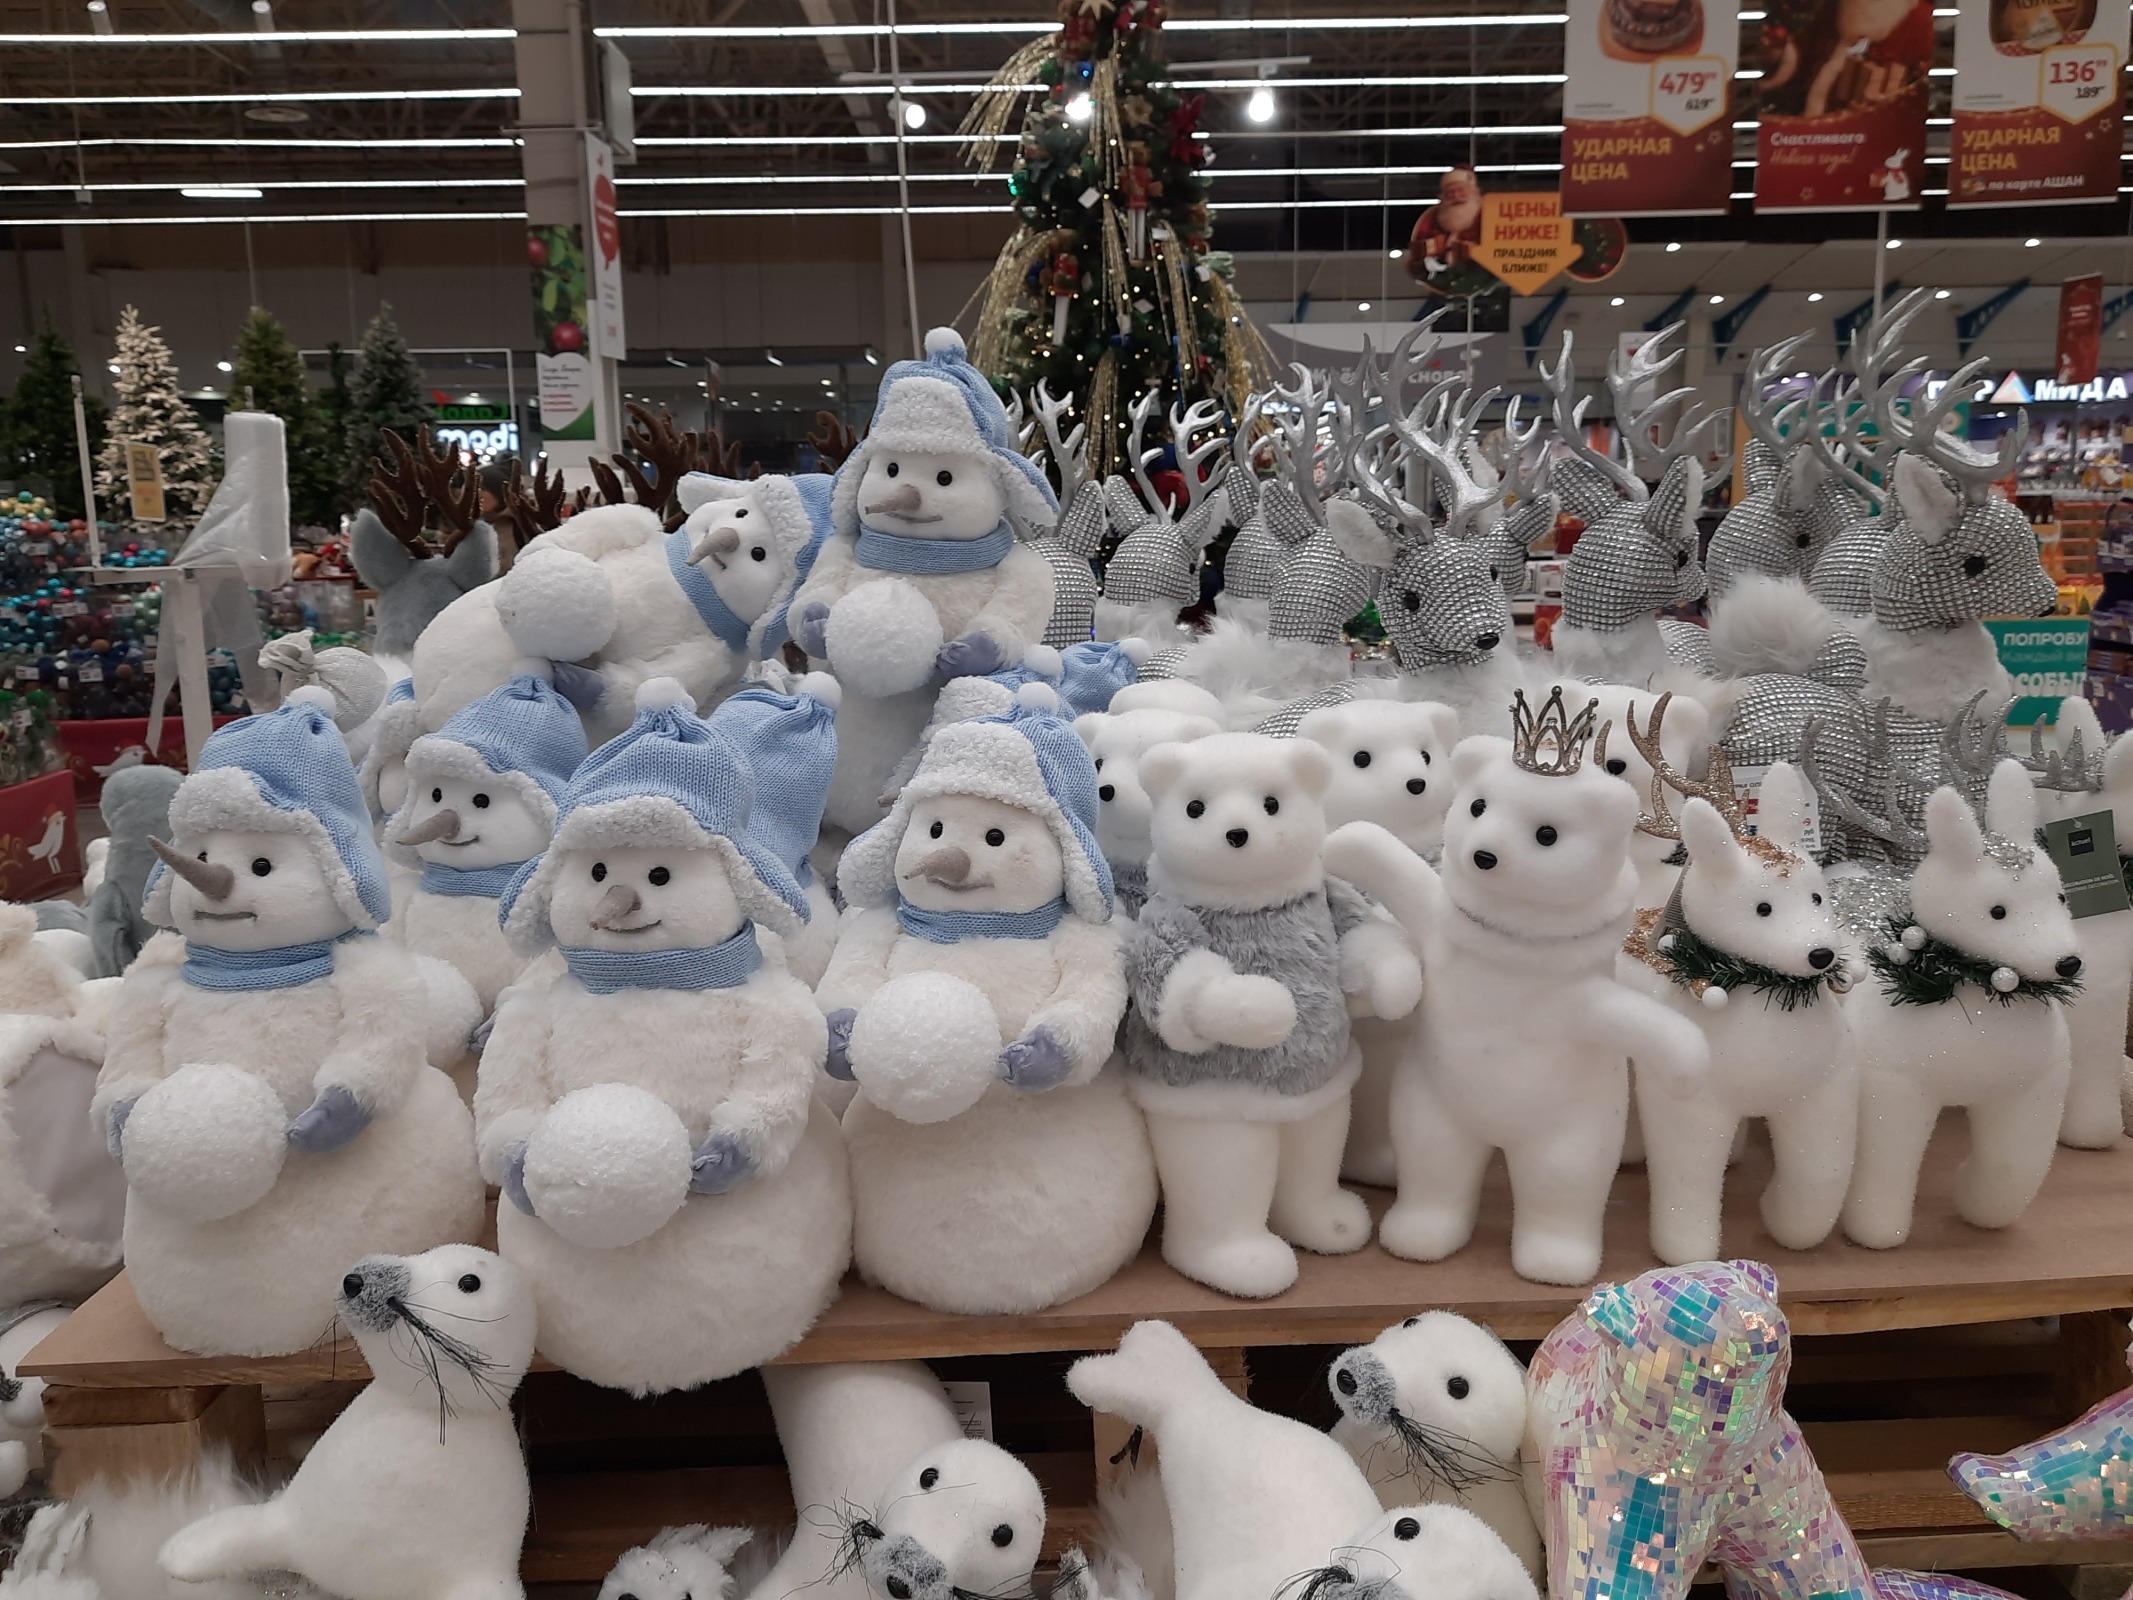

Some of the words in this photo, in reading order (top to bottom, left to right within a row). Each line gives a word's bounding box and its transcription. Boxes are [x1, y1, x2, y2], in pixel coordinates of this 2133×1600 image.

[1659, 71, 1706, 96] 479
[2050, 60, 2096, 84] 136
[1572, 137, 1673, 160] УДАРНАЯ
[1962, 126, 2061, 151] УДАРНАЯ
[1571, 162, 1629, 185] ЦЕНА
[1960, 152, 2017, 175] ЦЕНА
[2043, 175, 2084, 187] АШАН
[1499, 201, 1557, 221] ЦЕНЫ
[1494, 224, 1559, 241] НИЖЕ!
[1493, 247, 1557, 261] ПРАЗДНИК
[1501, 262, 1548, 274] БЛИЖЕ!
[436, 422, 519, 451] modi
[2003, 631, 2088, 646] ПОПРОБУ
